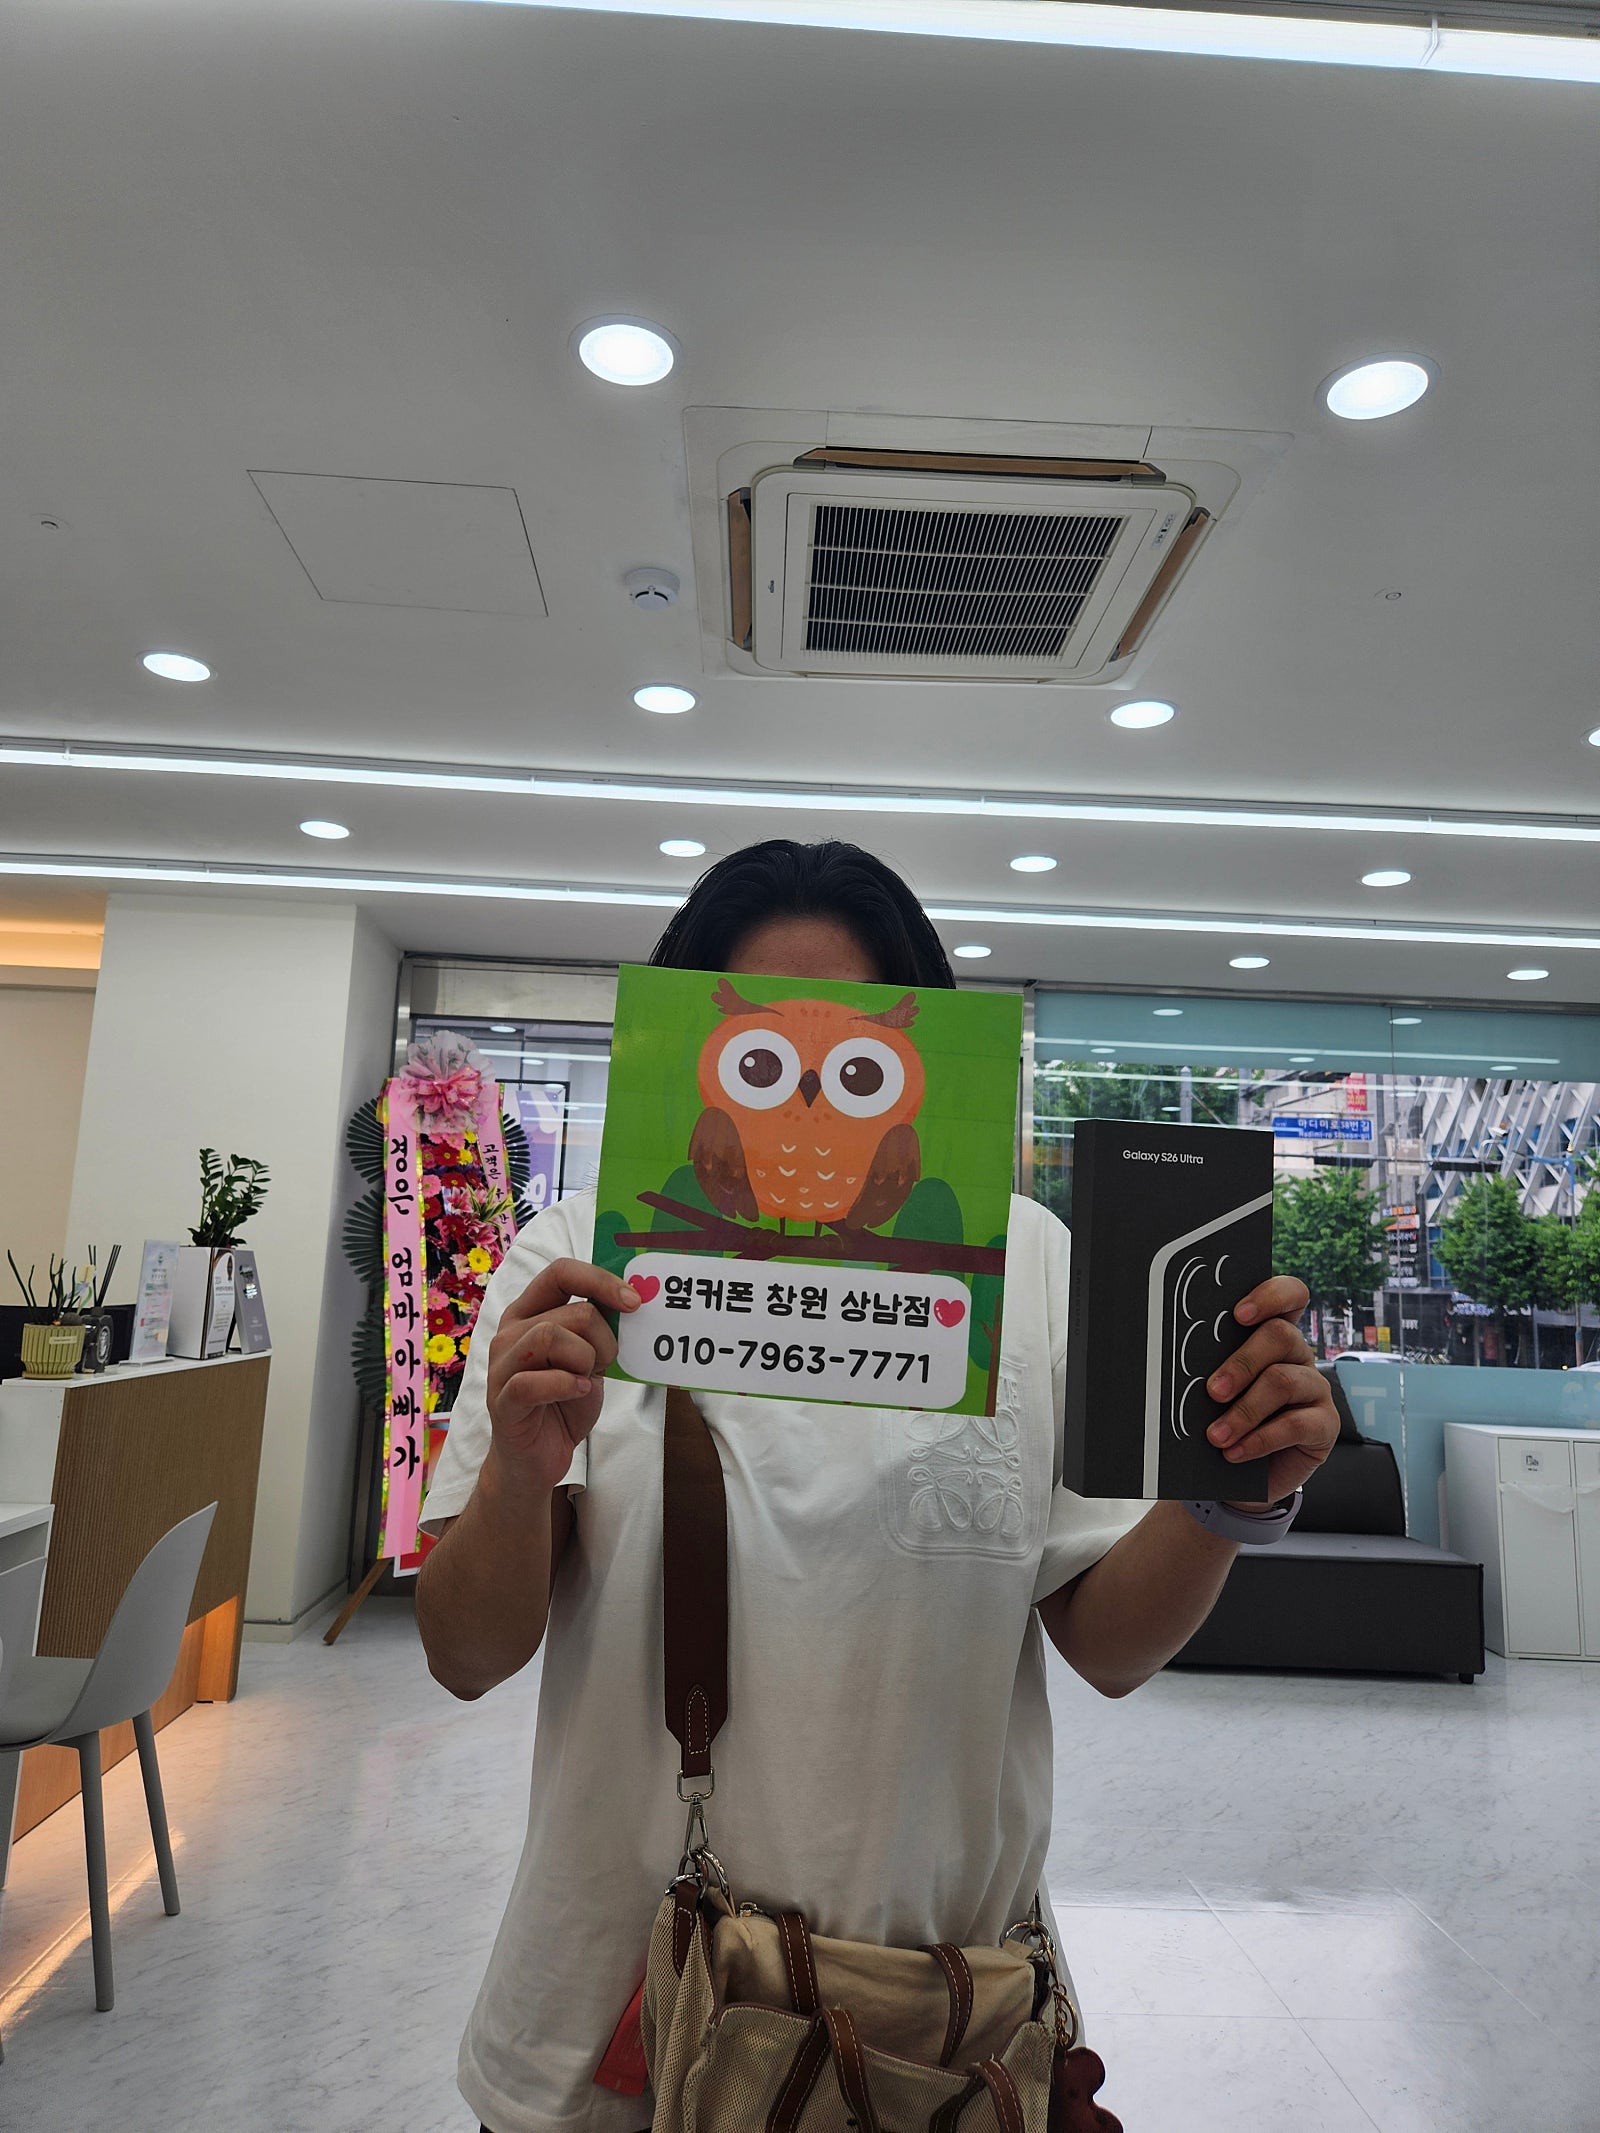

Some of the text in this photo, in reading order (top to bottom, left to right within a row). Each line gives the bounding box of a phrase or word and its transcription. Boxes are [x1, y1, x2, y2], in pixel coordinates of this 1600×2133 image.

[483, 1144, 502, 1180] 고객은
[1122, 1149, 1204, 1165] Galaxy S26 Ultra
[664, 1275, 931, 1328] 옆커폰 창원 상남점
[391, 1247, 421, 1480] 엄마아빠가
[653, 1334, 930, 1384] 010-7963-7771
